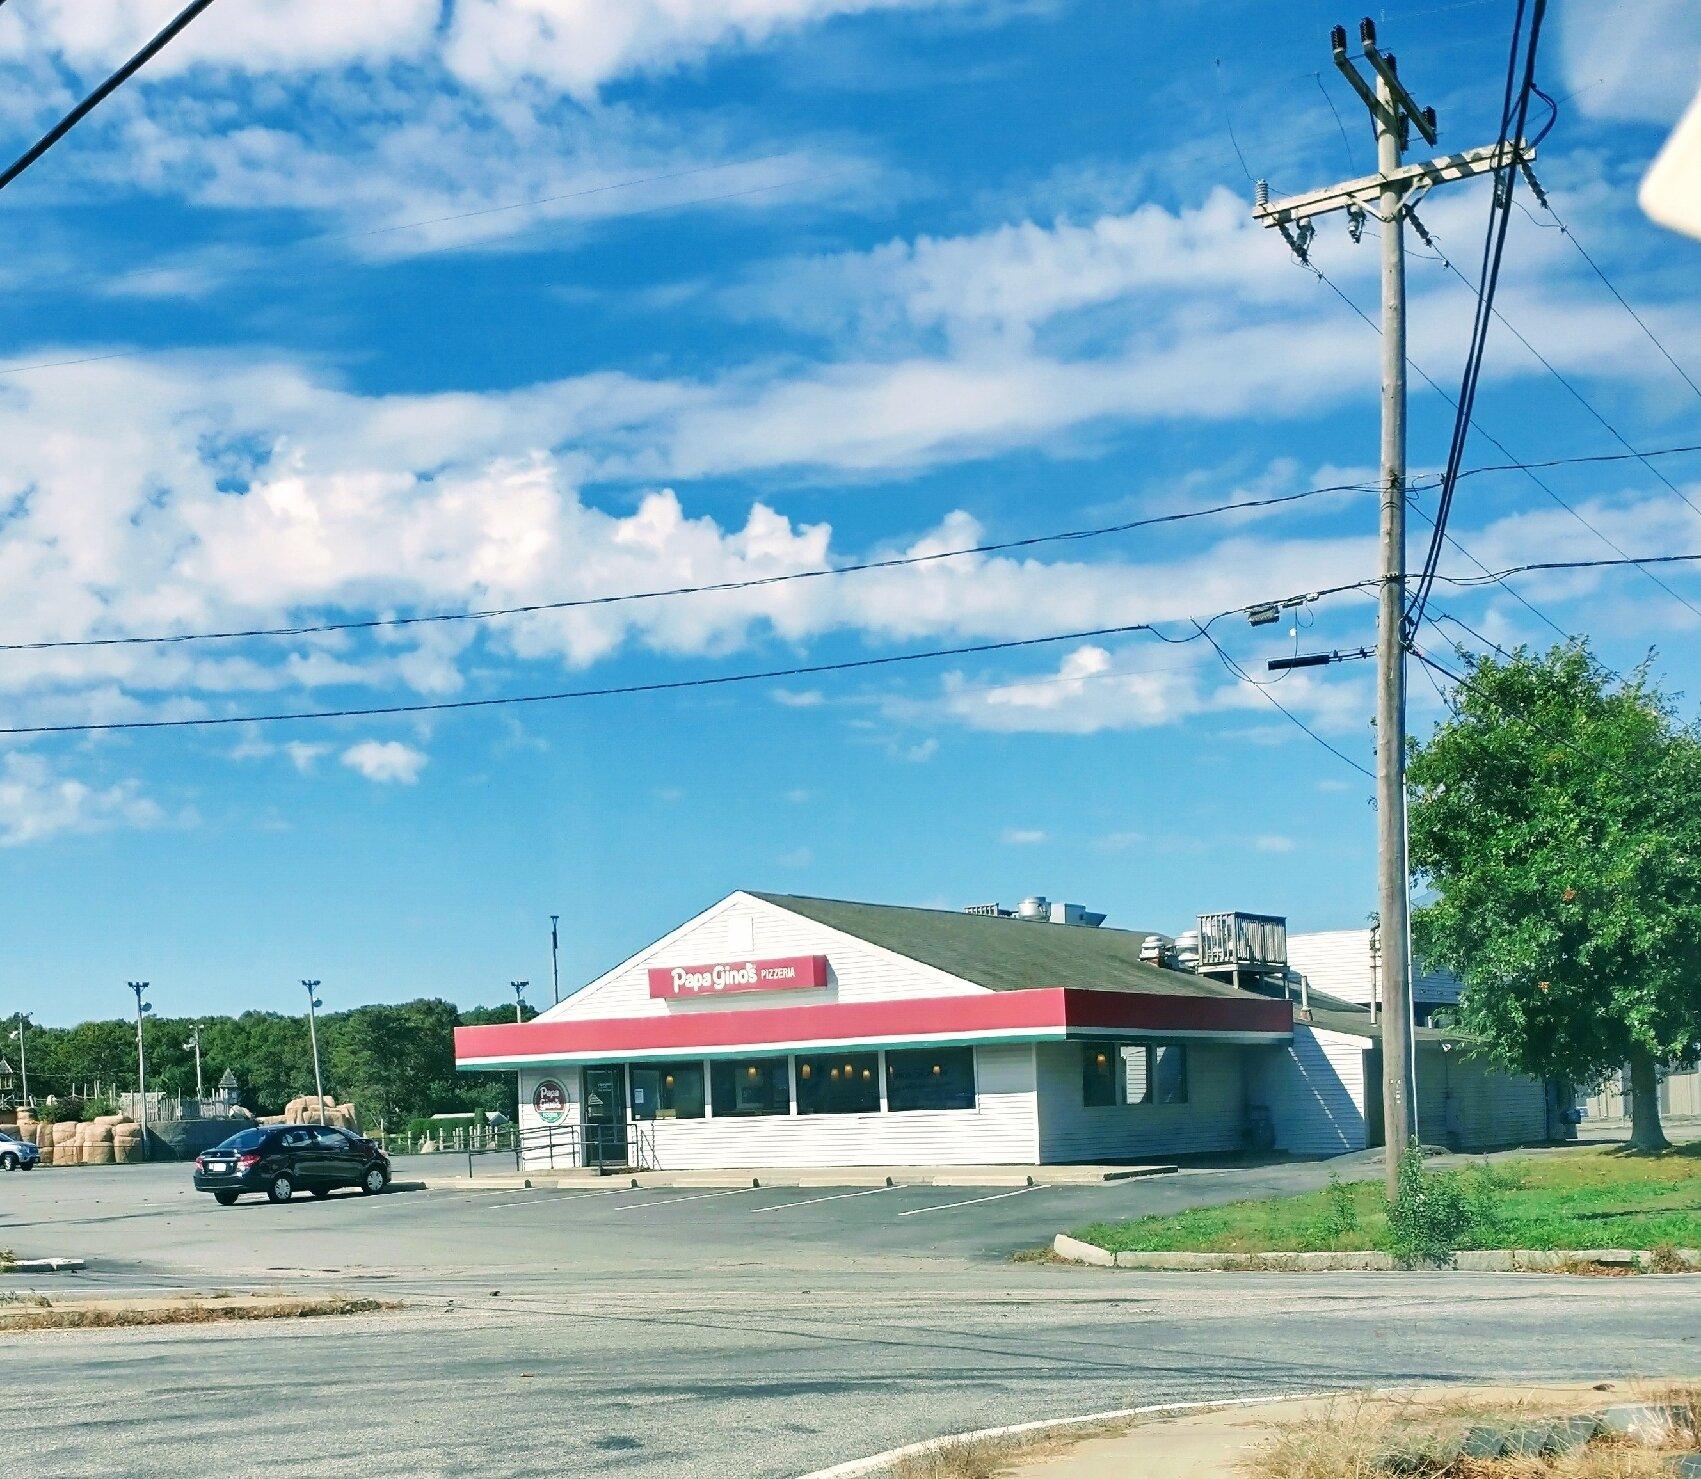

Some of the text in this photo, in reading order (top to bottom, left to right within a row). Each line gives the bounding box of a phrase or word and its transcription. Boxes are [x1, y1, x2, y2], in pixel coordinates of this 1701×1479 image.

[671, 963, 796, 993] Papa Gino's PIZZERIA
[540, 1086, 560, 1098] Papa
